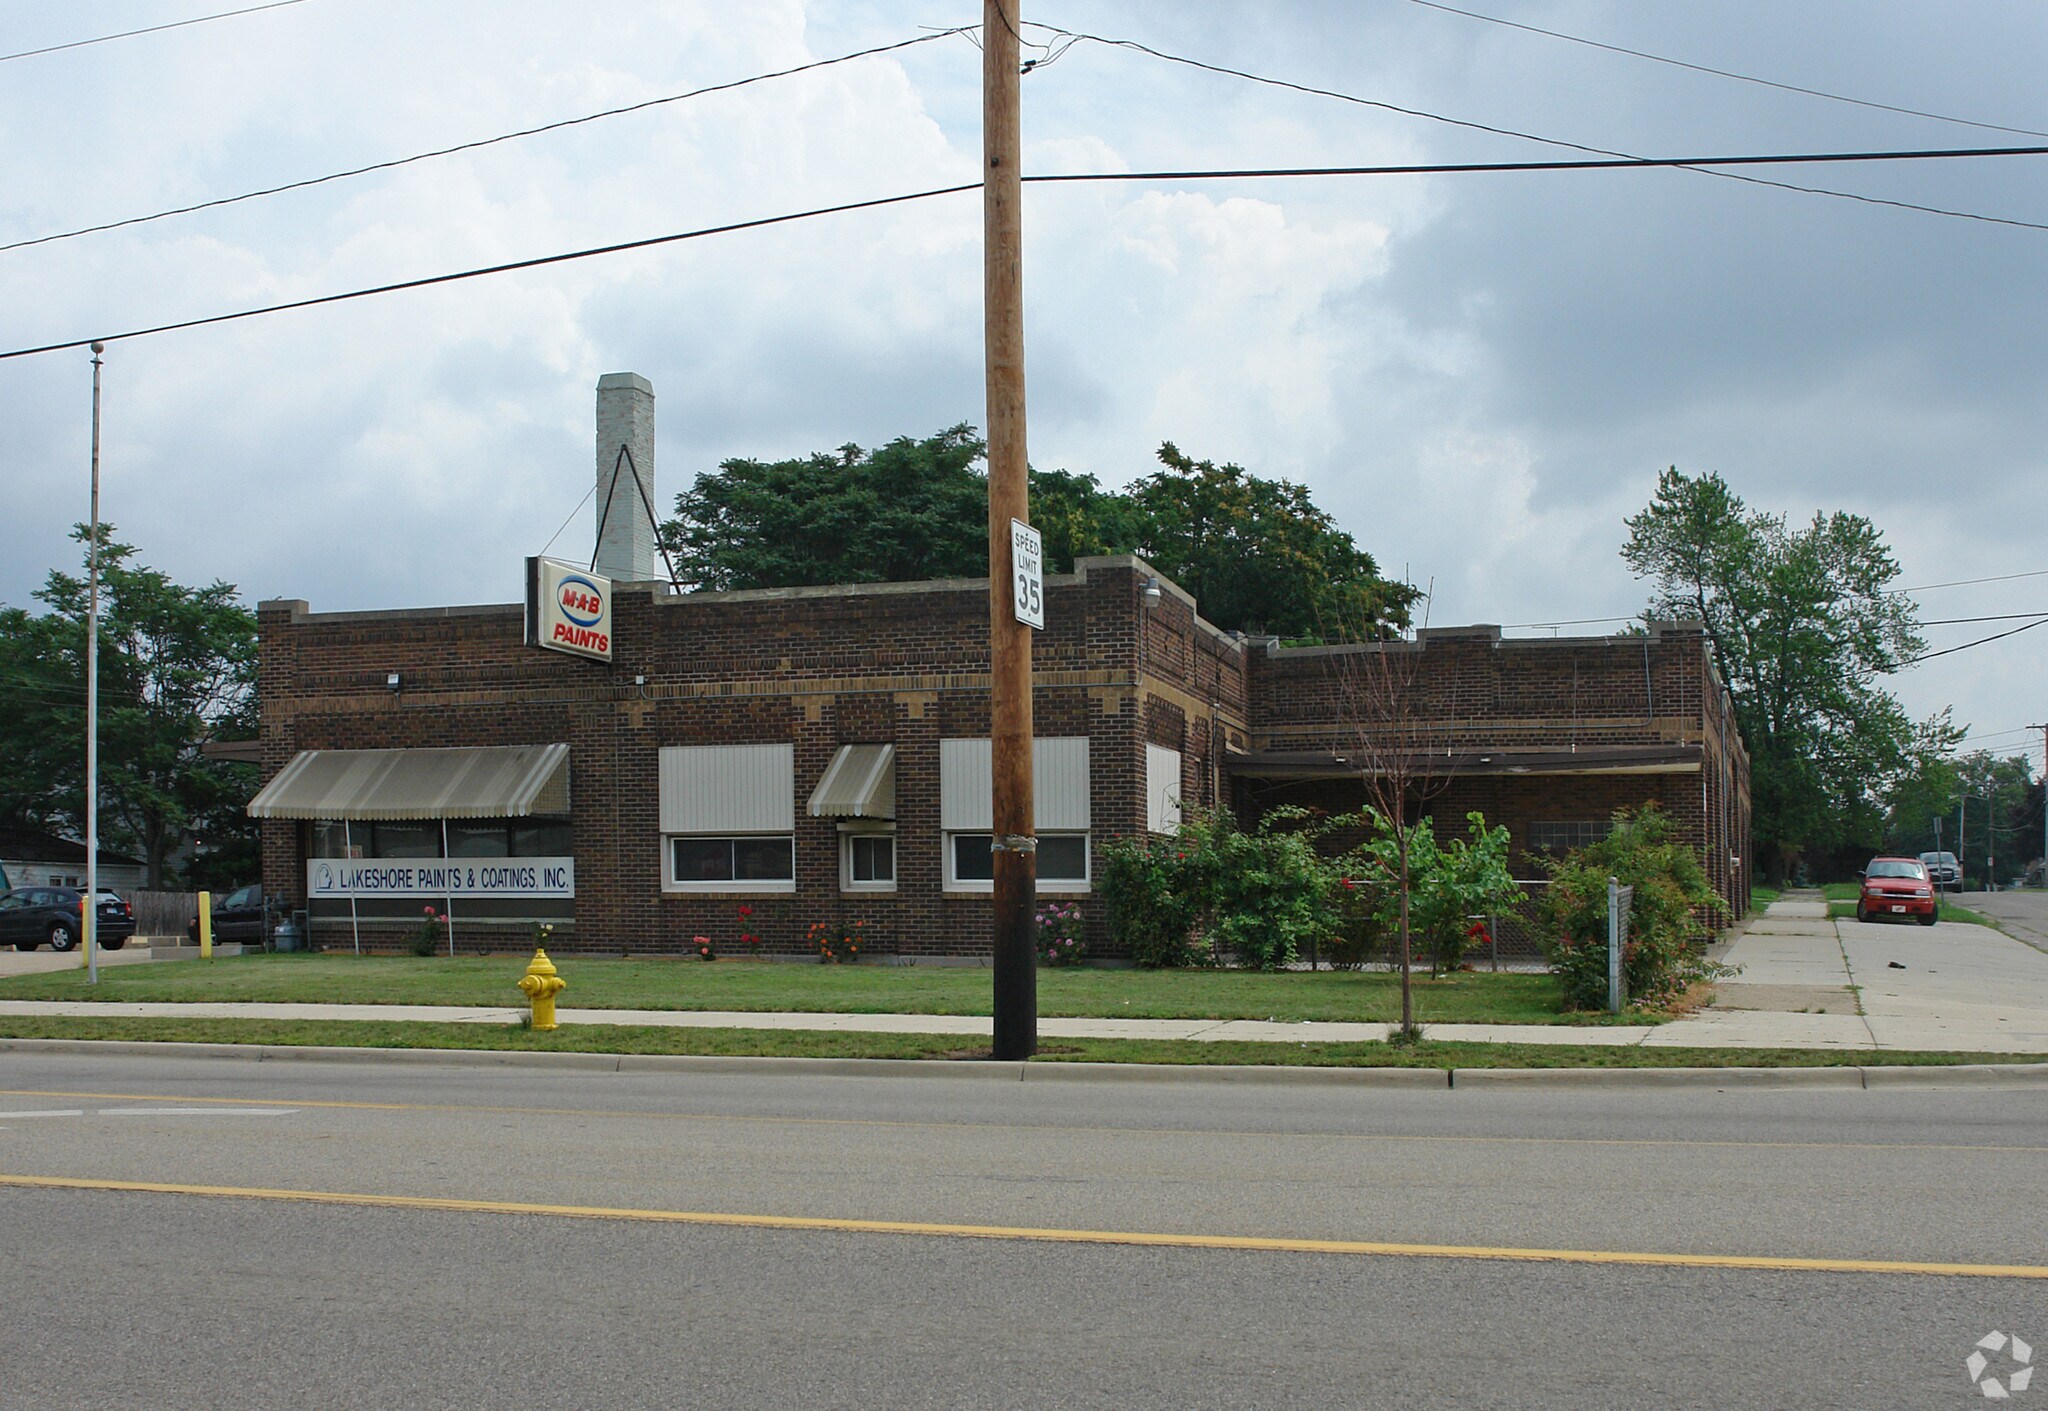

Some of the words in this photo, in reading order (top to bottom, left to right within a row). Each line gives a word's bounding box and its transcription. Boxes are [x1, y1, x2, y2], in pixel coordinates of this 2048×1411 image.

[1015, 533, 1039, 556] SPEED
[1018, 553, 1037, 575] LIMIT
[1018, 574, 1040, 614] 35
[553, 622, 608, 652] PAINTS
[340, 868, 413, 889] LAKESHORE
[418, 868, 462, 888] PAINTS
[467, 868, 475, 888] &
[481, 867, 538, 890] COATINGS,
[544, 867, 569, 888] INC.
